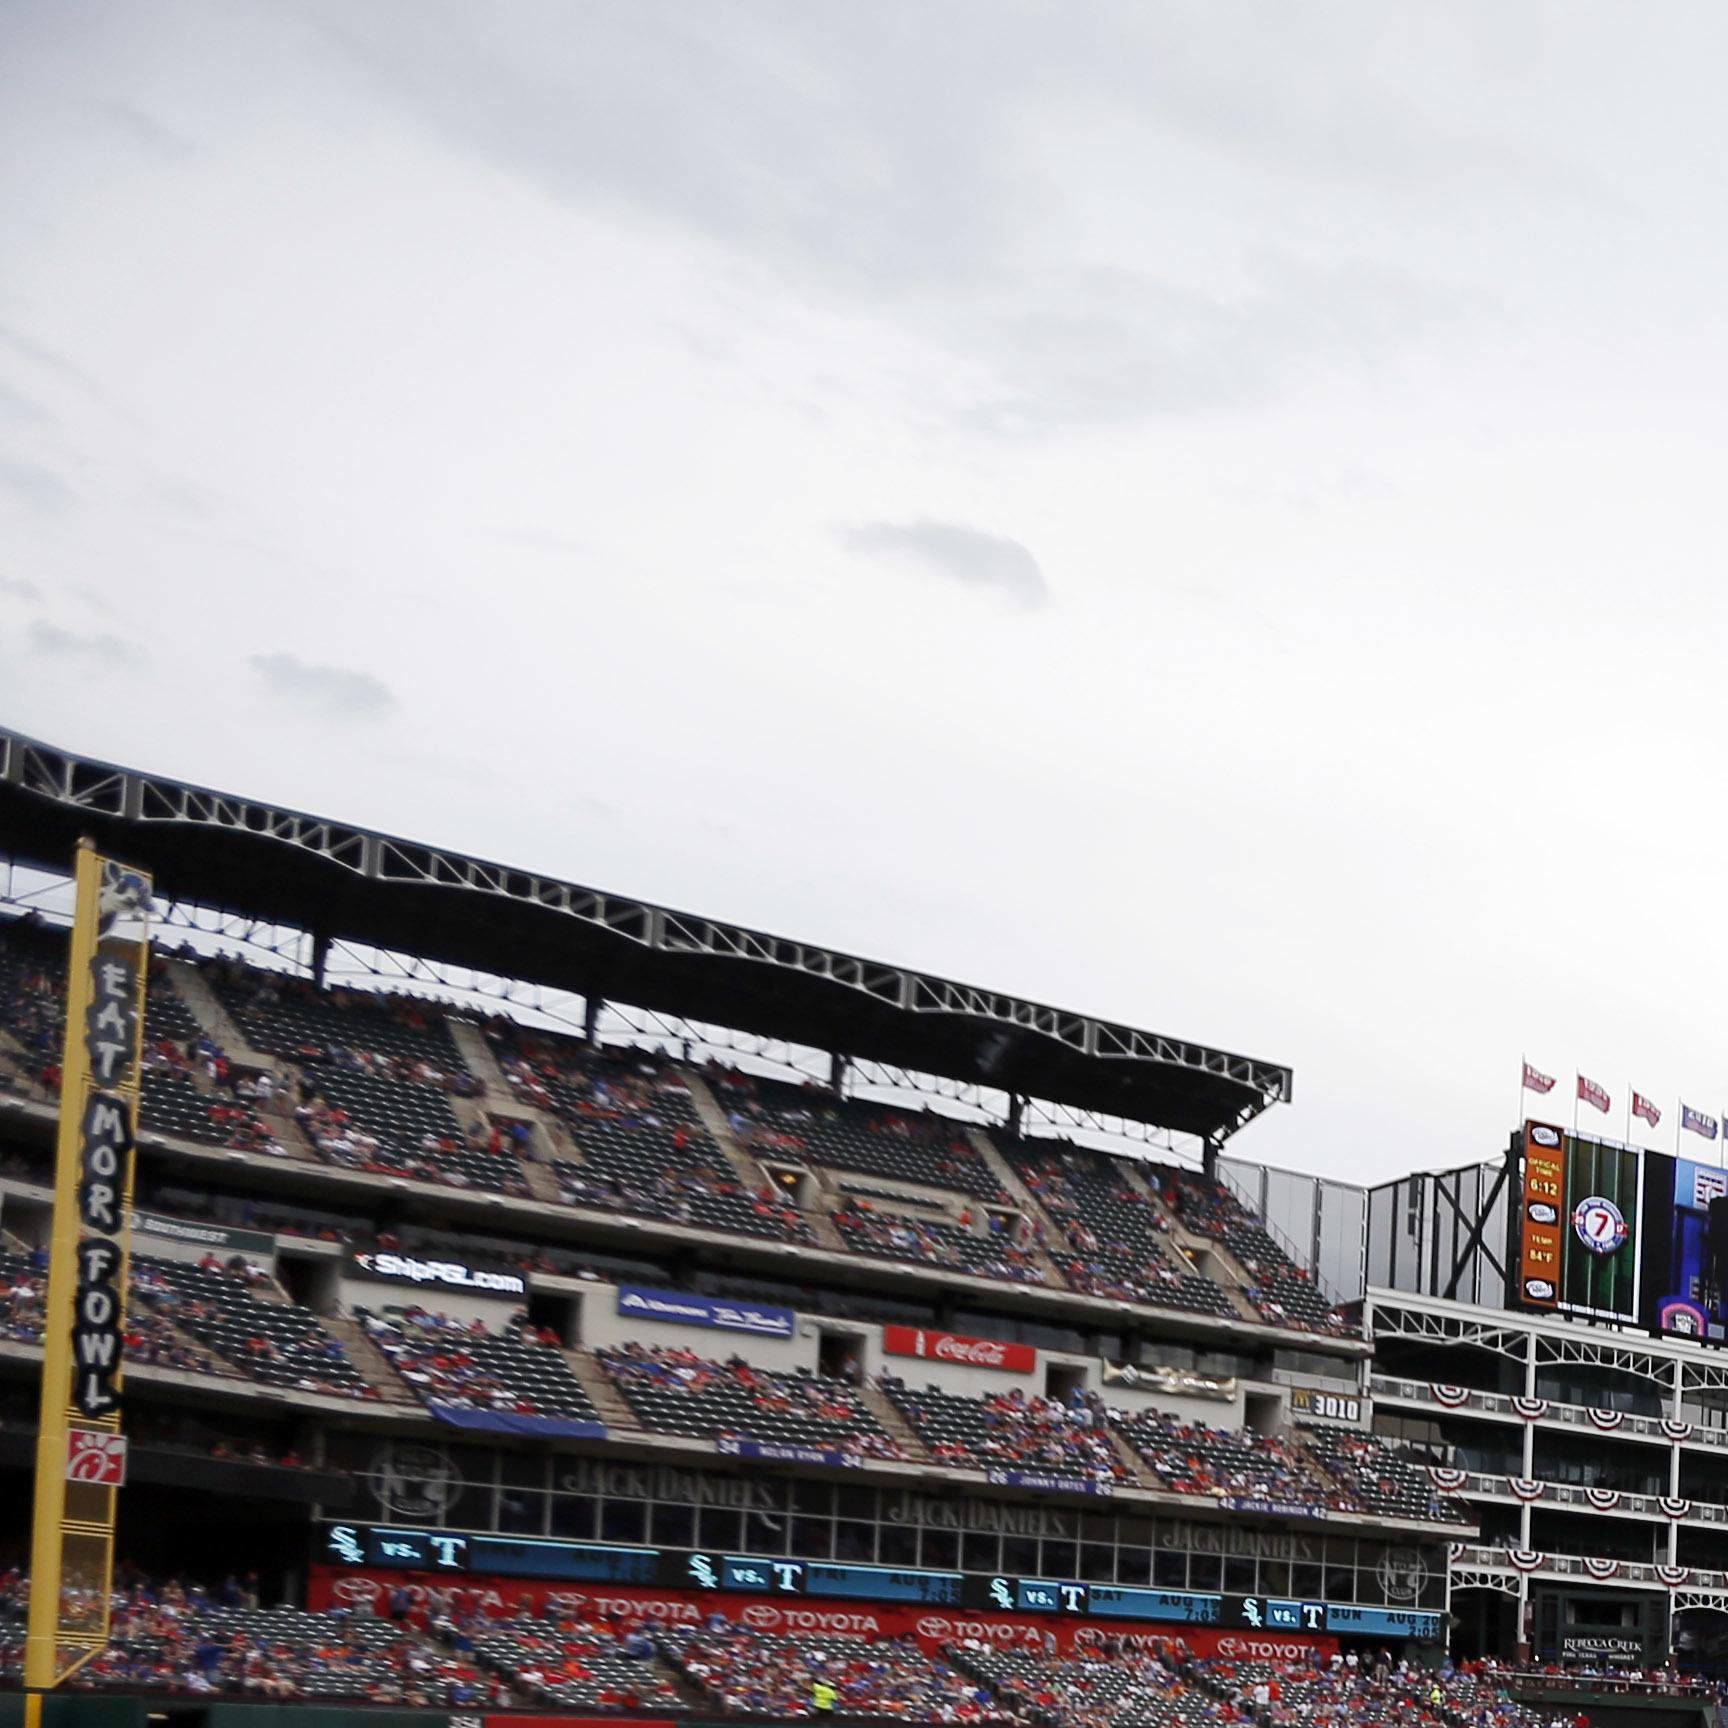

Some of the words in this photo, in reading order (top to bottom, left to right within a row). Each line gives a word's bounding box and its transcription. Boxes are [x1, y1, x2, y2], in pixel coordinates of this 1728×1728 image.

[93, 961, 128, 1080] EAT
[90, 1103, 125, 1225] MOR
[1531, 1179, 1557, 1195] 6:12
[1594, 1213, 1608, 1237] 7
[1532, 1235, 1553, 1245] TEMP
[80, 1249, 115, 1409] FOWL
[935, 1336, 1007, 1365] Coca-Cola
[1313, 1396, 1360, 1421] 3010
[719, 1440, 740, 1455] 34
[841, 1453, 861, 1468] 34
[562, 1463, 647, 1499] JACK
[989, 1469, 1008, 1485] 26
[1019, 1476, 1056, 1490] JOHNNY
[1095, 1482, 1113, 1496] 26
[889, 1493, 959, 1528] JACK
[1220, 1498, 1236, 1510] 42
[1240, 1500, 1269, 1513] JACKIE
[1271, 1503, 1308, 1516] ROBINSON
[1310, 1506, 1327, 1519] 42
[381, 1540, 421, 1558] vs.
[1162, 1525, 1220, 1553] JACK
[732, 1568, 765, 1585] vs.
[594, 1597, 700, 1621] TOYOTA
[1025, 1590, 1053, 1605] vs.
[1160, 1595, 1197, 1607] AUG
[783, 1610, 879, 1632] TOYOTA
[1185, 1609, 1219, 1622] 7:05
[1272, 1608, 1296, 1623] vs.
[1331, 1608, 1362, 1621] SUN
[1386, 1613, 1419, 1625] AUG
[1422, 1616, 1440, 1627] 20
[1408, 1625, 1440, 1638] 2:05
